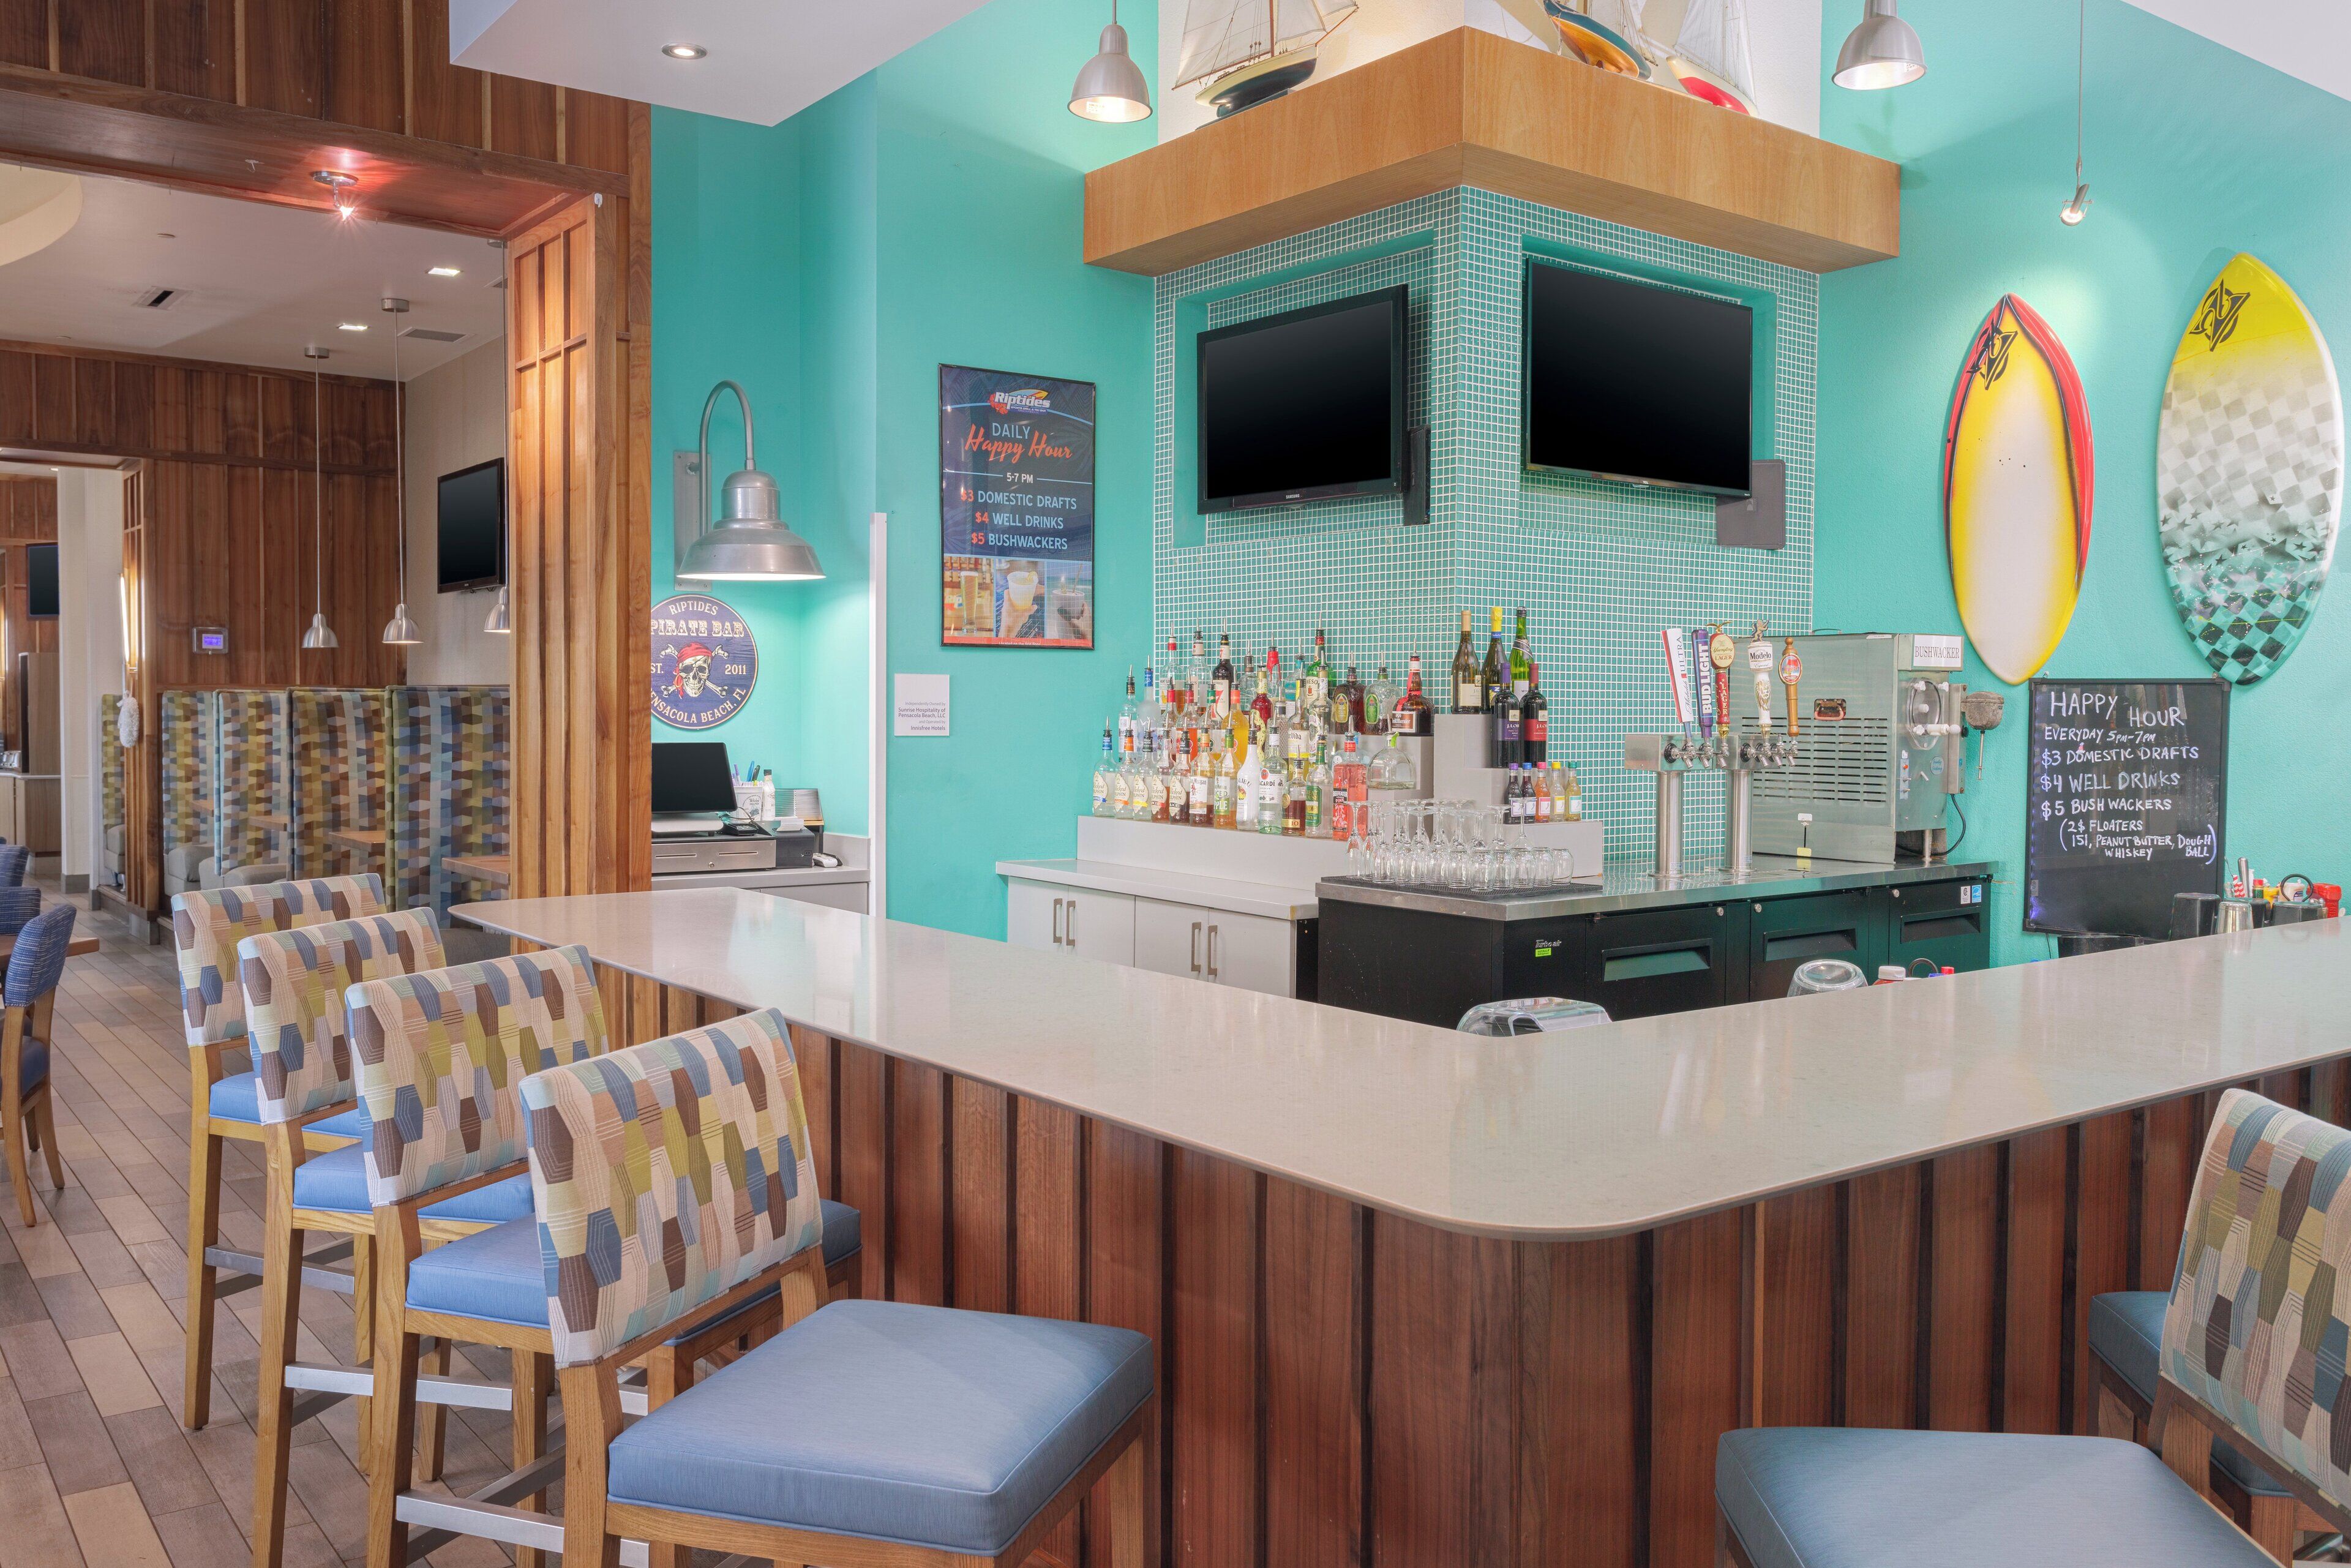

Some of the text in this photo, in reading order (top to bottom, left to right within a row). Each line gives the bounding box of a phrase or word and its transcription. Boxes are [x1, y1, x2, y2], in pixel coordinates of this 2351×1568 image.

[994, 392, 1051, 410] Riptides
[992, 422, 1030, 439] DAILY
[965, 423, 1072, 464] Happy Hour
[1007, 472, 1033, 483] 5-7 PM
[960, 490, 1077, 510] $3 DOMESTIC DRAFTS
[975, 512, 1064, 529] $4 WELL DRINKS
[971, 532, 1068, 550] $5 BUSHWACKERS
[669, 601, 718, 615] RIPTIDES
[651, 619, 744, 637] PIRATE BAR
[1220, 649, 1225, 658] 7
[1677, 637, 1685, 672] ULTRA
[1750, 652, 1772, 660] Modelo
[1915, 646, 1959, 658] BUSHWACKER
[651, 664, 664, 673] ST.
[725, 664, 746, 674] 2011
[1698, 643, 1712, 714] BUD LIGHT
[651, 688, 746, 723] ENSACOLA BEACH, FL
[2051, 691, 2185, 727] HAPPY HOUR
[2045, 727, 2104, 744] EVERYDAY
[2042, 746, 2199, 769] $3 DOMESTIC DRAFTS
[2040, 770, 2180, 793] $4 WELL DRINKS
[2089, 819, 2143, 832] FLOATERS
[2096, 835, 2132, 847] PEANUT
[2105, 848, 2152, 861] WHISKEY
